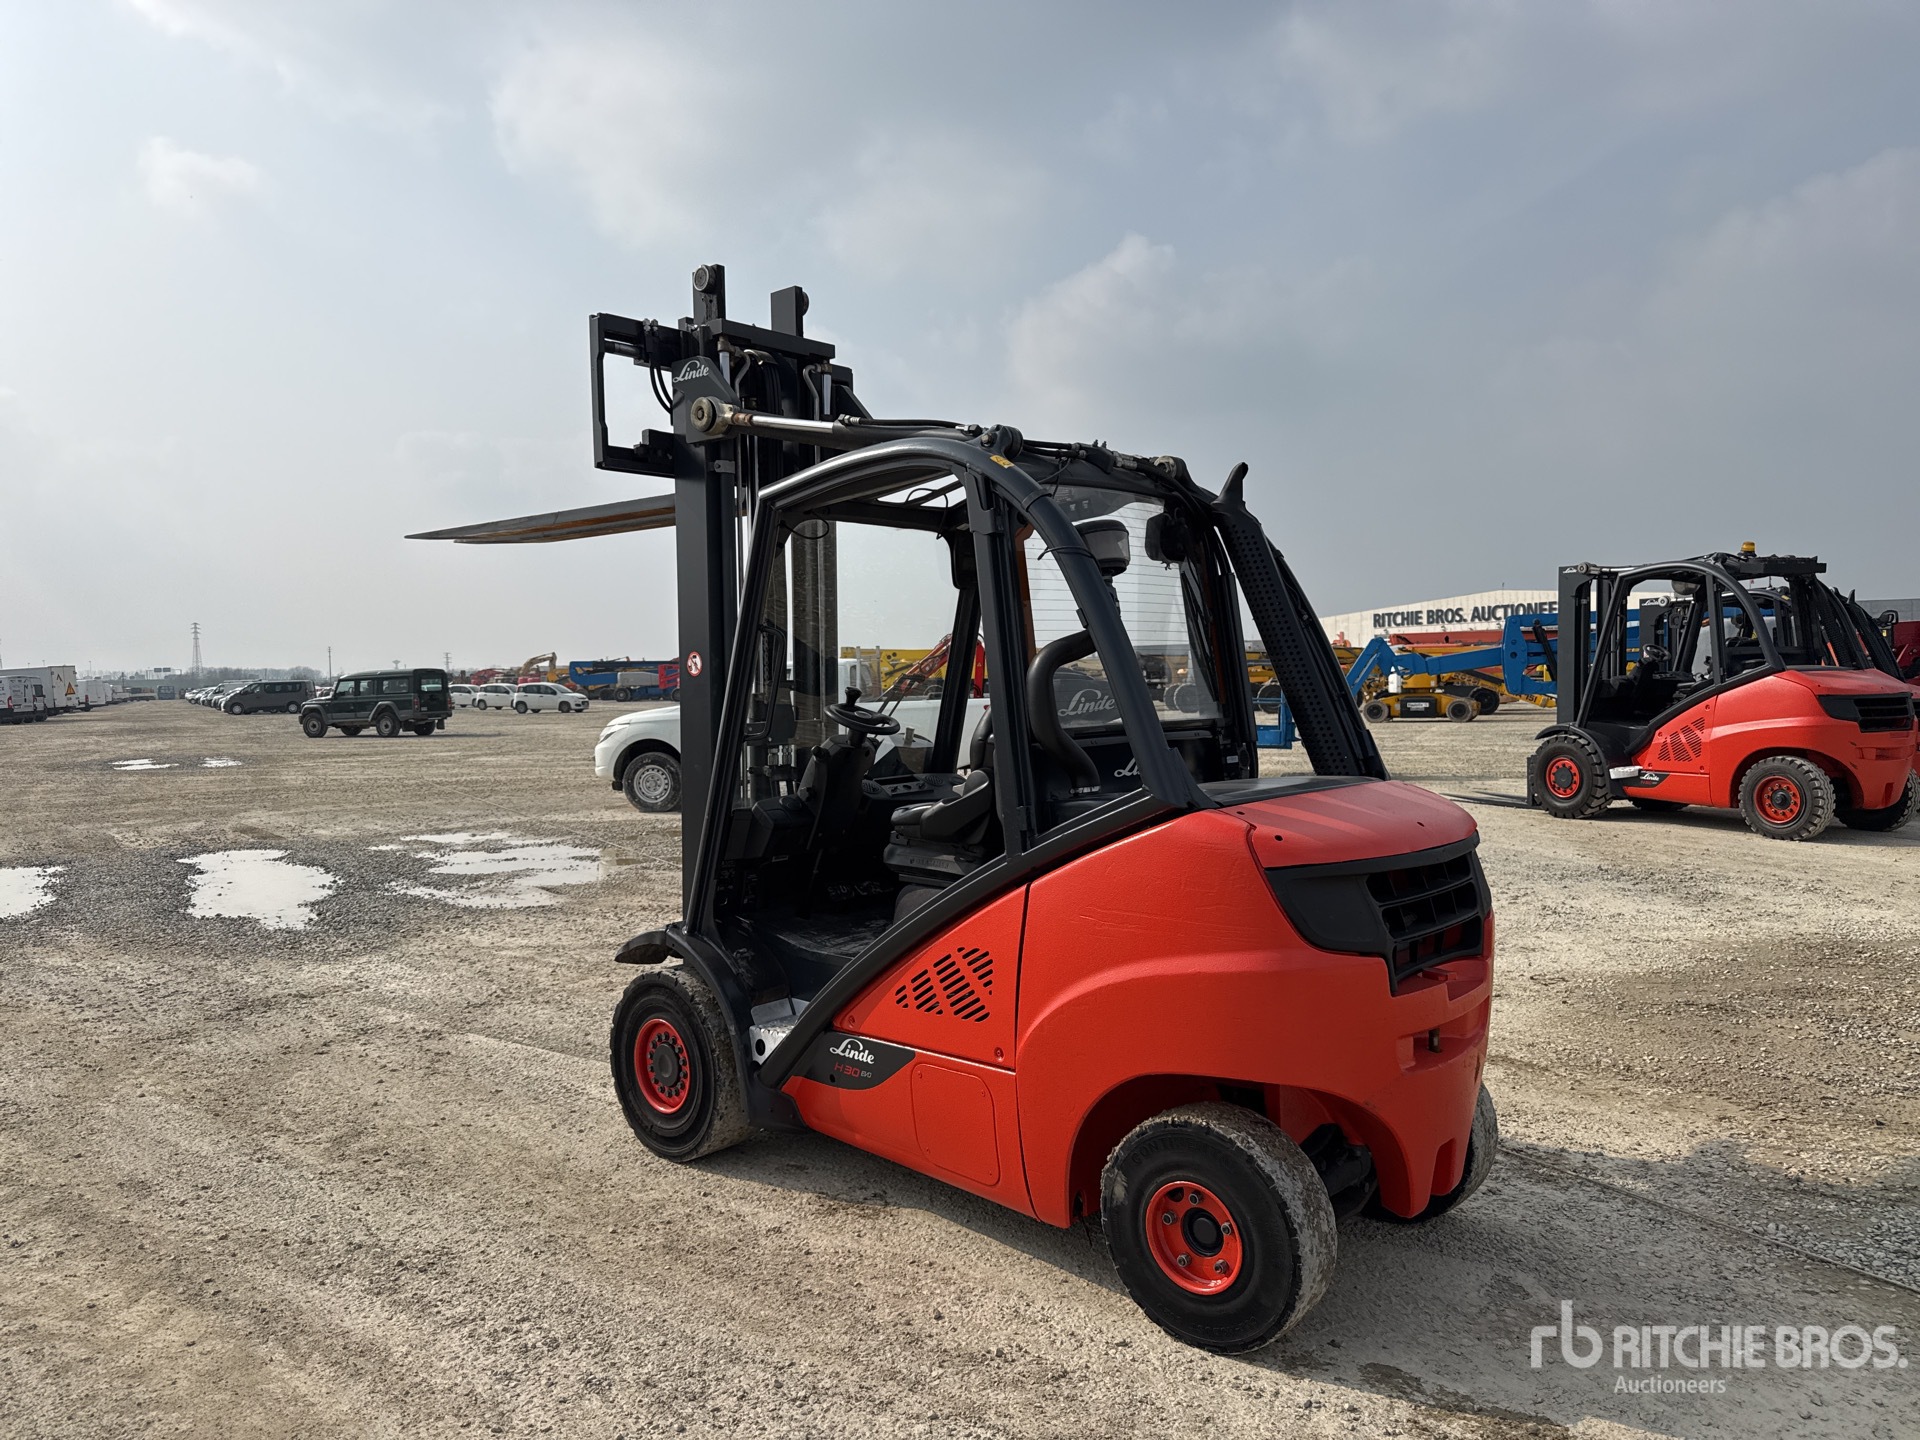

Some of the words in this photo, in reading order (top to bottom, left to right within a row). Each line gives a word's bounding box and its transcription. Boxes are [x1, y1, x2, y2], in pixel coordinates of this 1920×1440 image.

[673, 360, 709, 383] Linde
[1373, 610, 1423, 628] RITCHIE
[1426, 607, 1468, 624] BROS.
[1058, 688, 1115, 716] Linde
[1640, 772, 1660, 781] Linde
[830, 1038, 875, 1065] Linde
